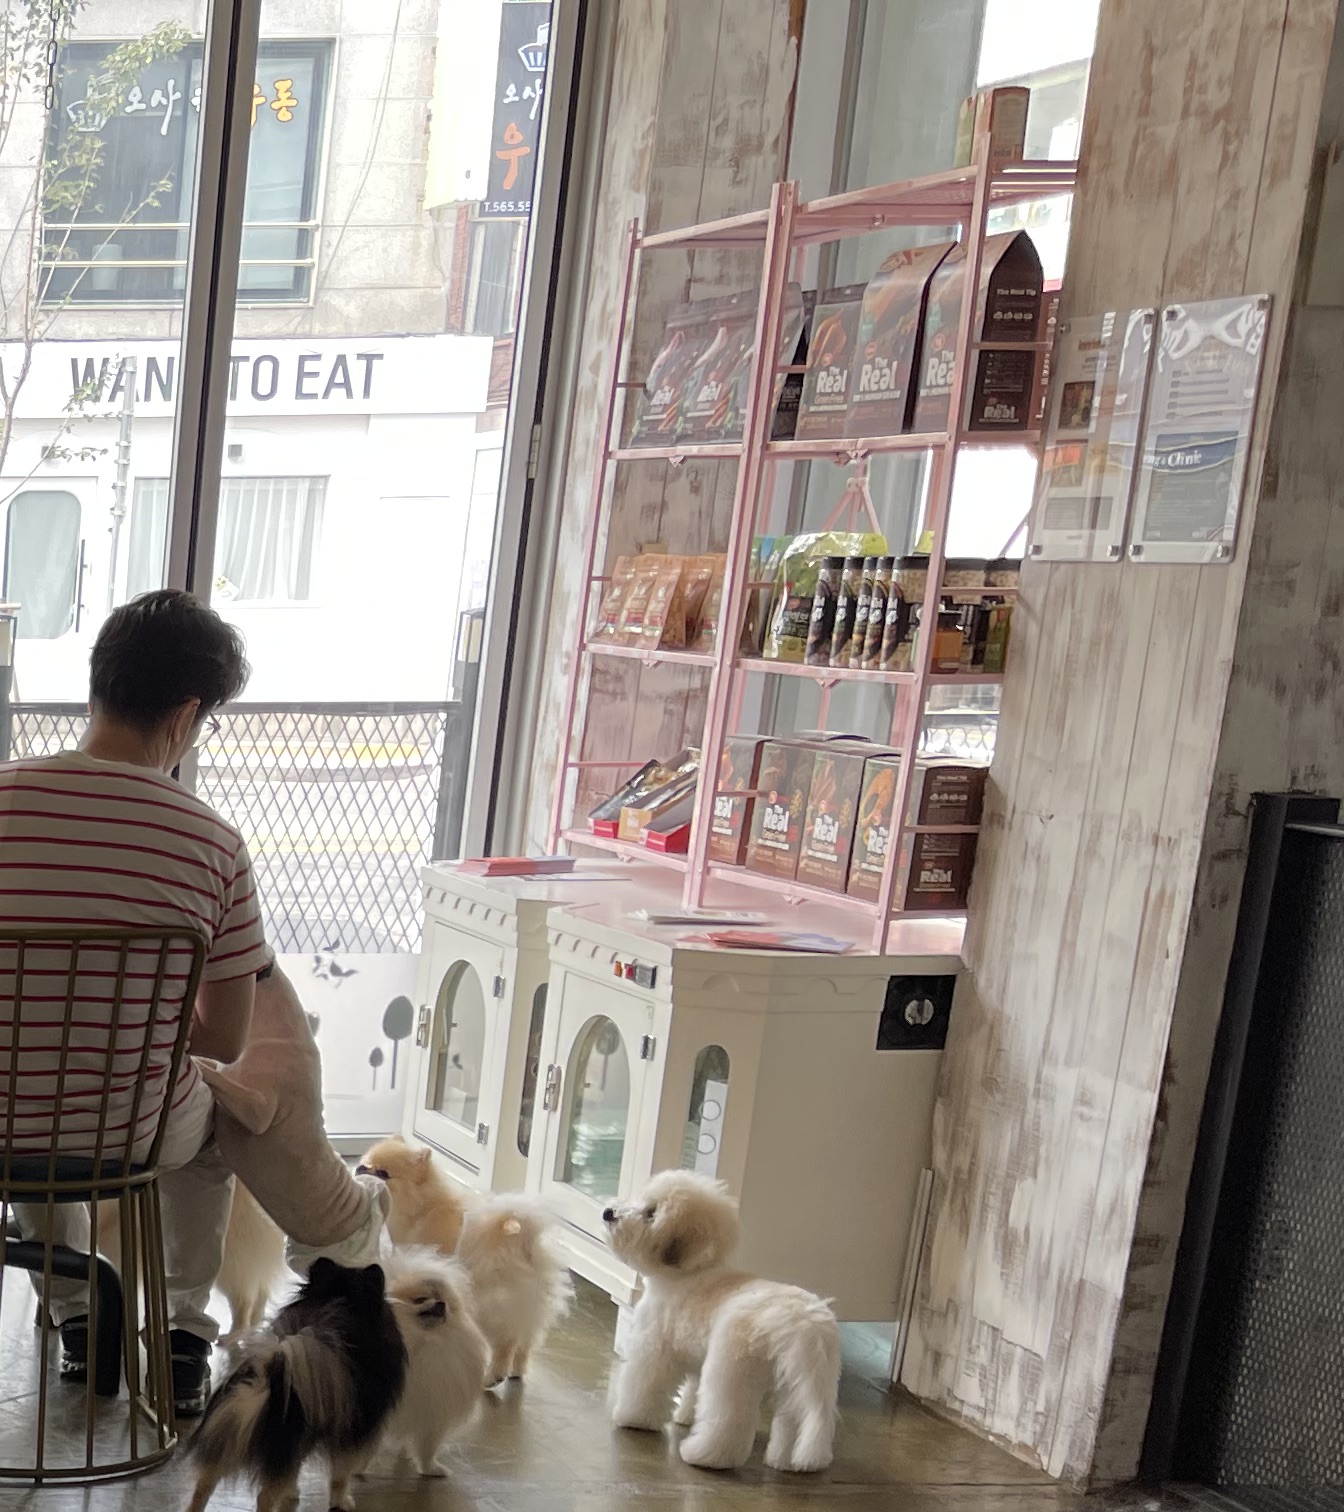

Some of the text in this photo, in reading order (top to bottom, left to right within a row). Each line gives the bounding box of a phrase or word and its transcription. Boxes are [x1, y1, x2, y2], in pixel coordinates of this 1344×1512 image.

[229, 354, 280, 402] TO
[294, 353, 385, 400] EAT
[816, 369, 848, 393] Real
[859, 361, 899, 391] Real
[926, 357, 955, 386] Rea
[763, 807, 790, 832] Real
[813, 816, 839, 843] Real
[867, 829, 889, 854] Rea
